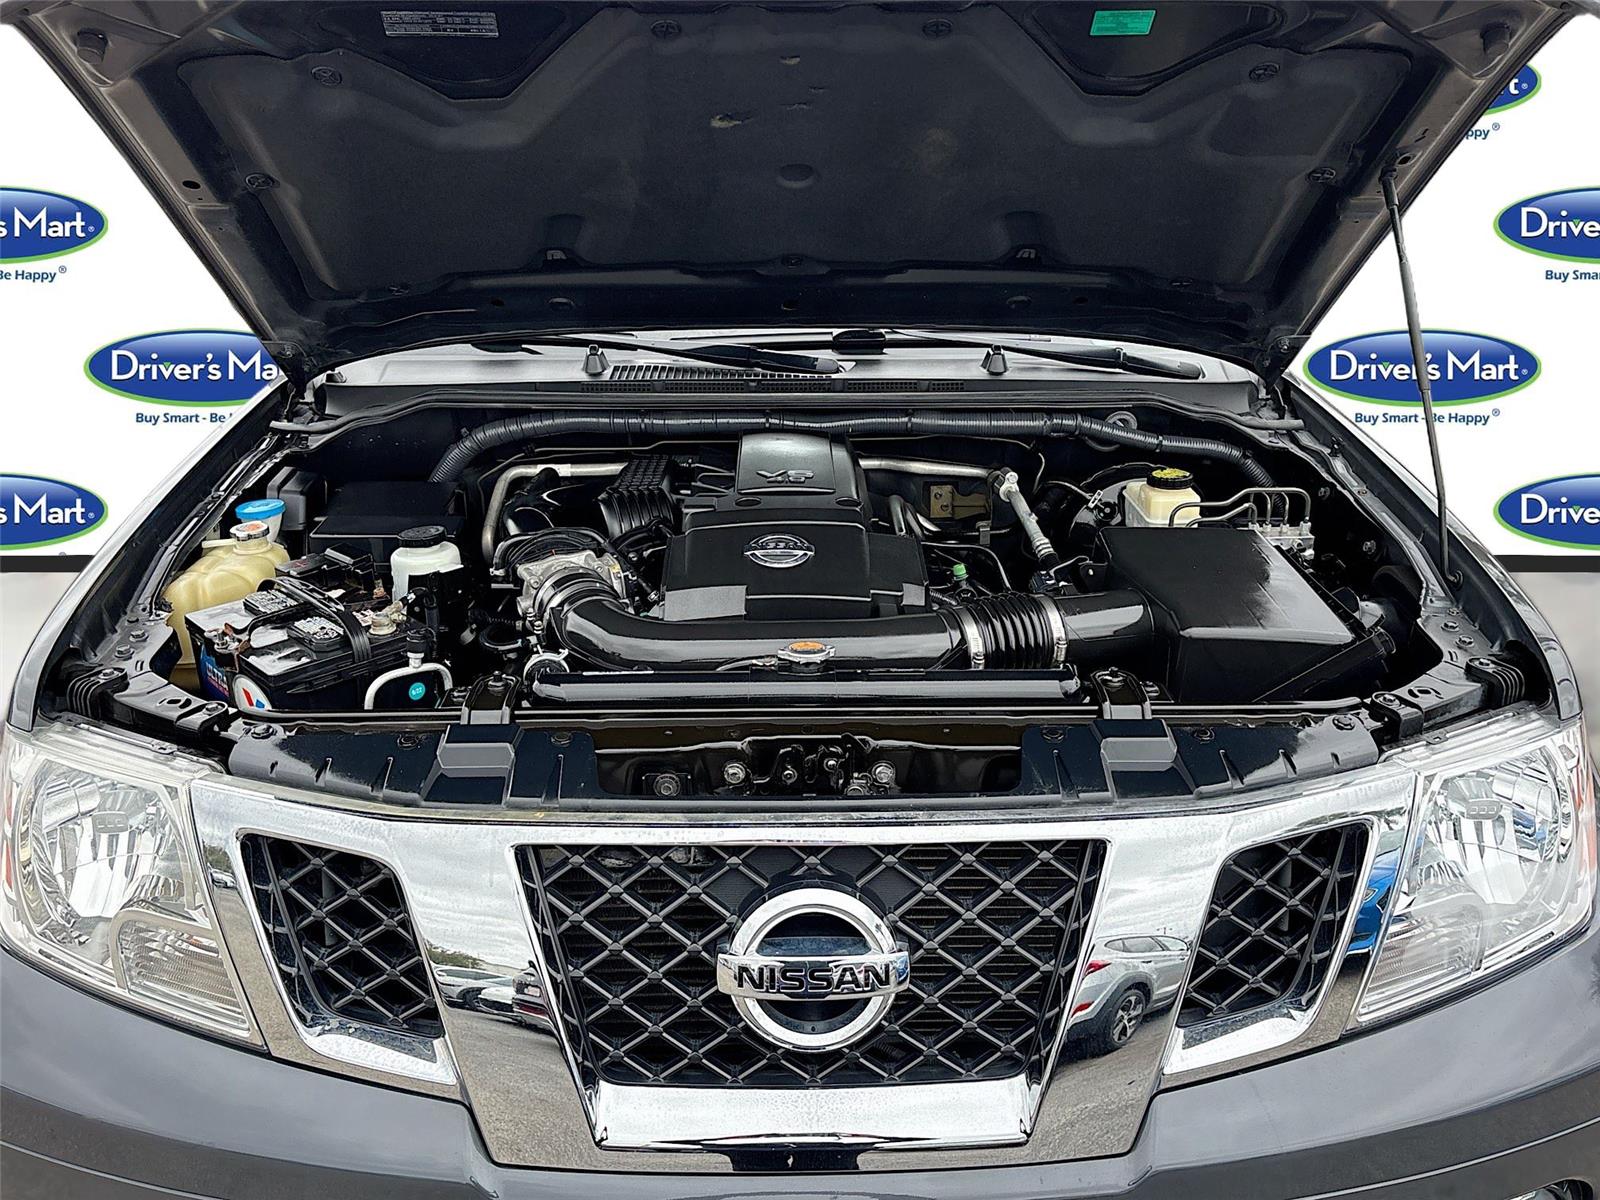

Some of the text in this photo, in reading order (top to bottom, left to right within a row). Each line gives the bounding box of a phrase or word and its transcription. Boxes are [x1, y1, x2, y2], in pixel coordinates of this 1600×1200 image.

[1466, 129, 1490, 140] ppy
[14, 207, 86, 237] Mart
[15, 270, 57, 283] Happy
[1545, 270, 1600, 283] Buy Sma
[111, 350, 279, 380] Driver's Ma
[1447, 350, 1519, 380] Mart
[136, 413, 160, 425] Buy
[163, 412, 199, 423] Smart
[210, 413, 226, 423] Be
[1355, 413, 1379, 425] Buy
[1382, 412, 1419, 423] Smart
[1448, 413, 1490, 426] Happy
[14, 493, 86, 523] Mart
[751, 541, 808, 550] NISSAN
[737, 963, 890, 992] NISSAN
